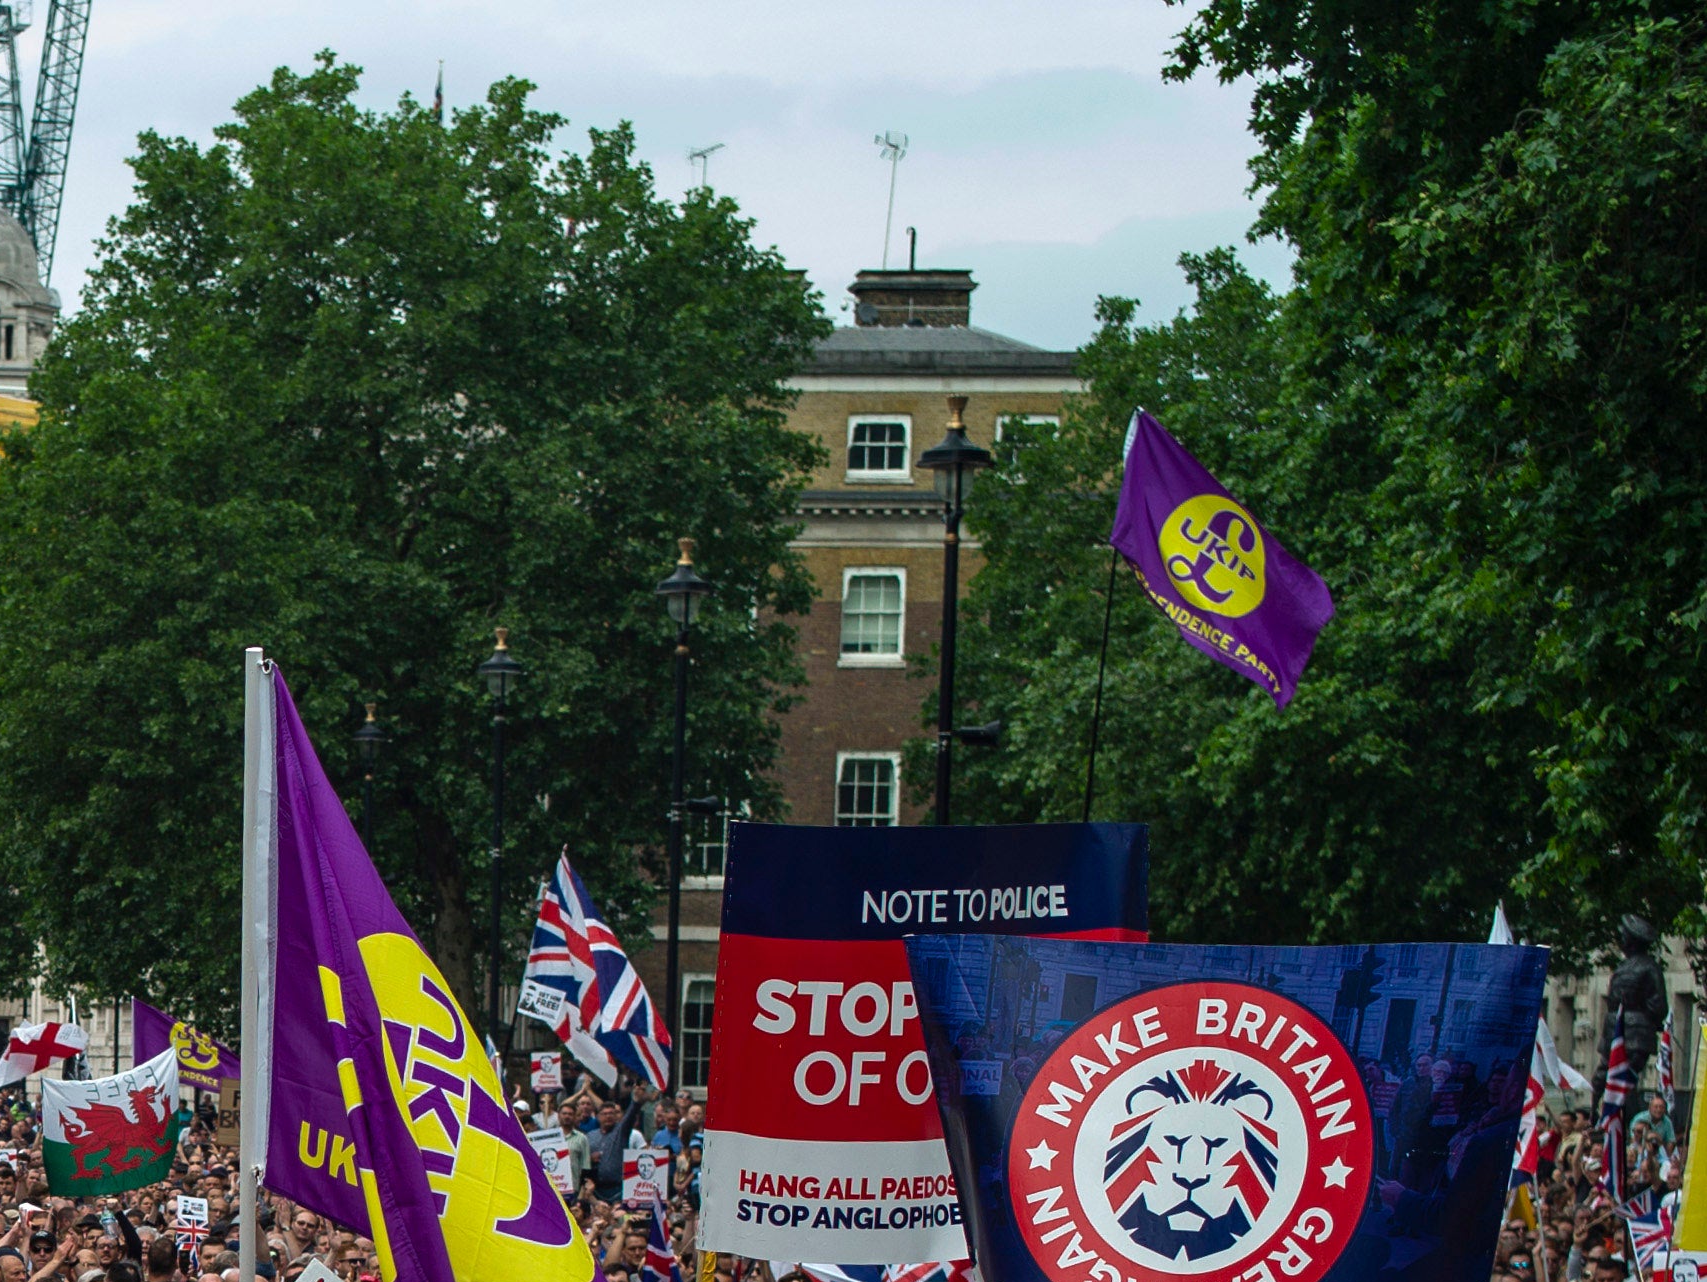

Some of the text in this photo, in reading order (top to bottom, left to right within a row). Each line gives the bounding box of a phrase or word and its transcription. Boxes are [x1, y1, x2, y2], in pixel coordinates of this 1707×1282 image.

[1181, 517, 1255, 581] UKIP
[1235, 643, 1281, 694] PARTY
[862, 884, 1069, 924] NOTE TO POLICE
[752, 979, 920, 1038] STOP
[793, 1050, 934, 1107] OF O
[1035, 998, 1356, 1140] MAKE BRITAIN
[739, 1168, 821, 1199] HANG
[824, 1176, 878, 1200] ALL
[736, 1199, 812, 1228] STOP
